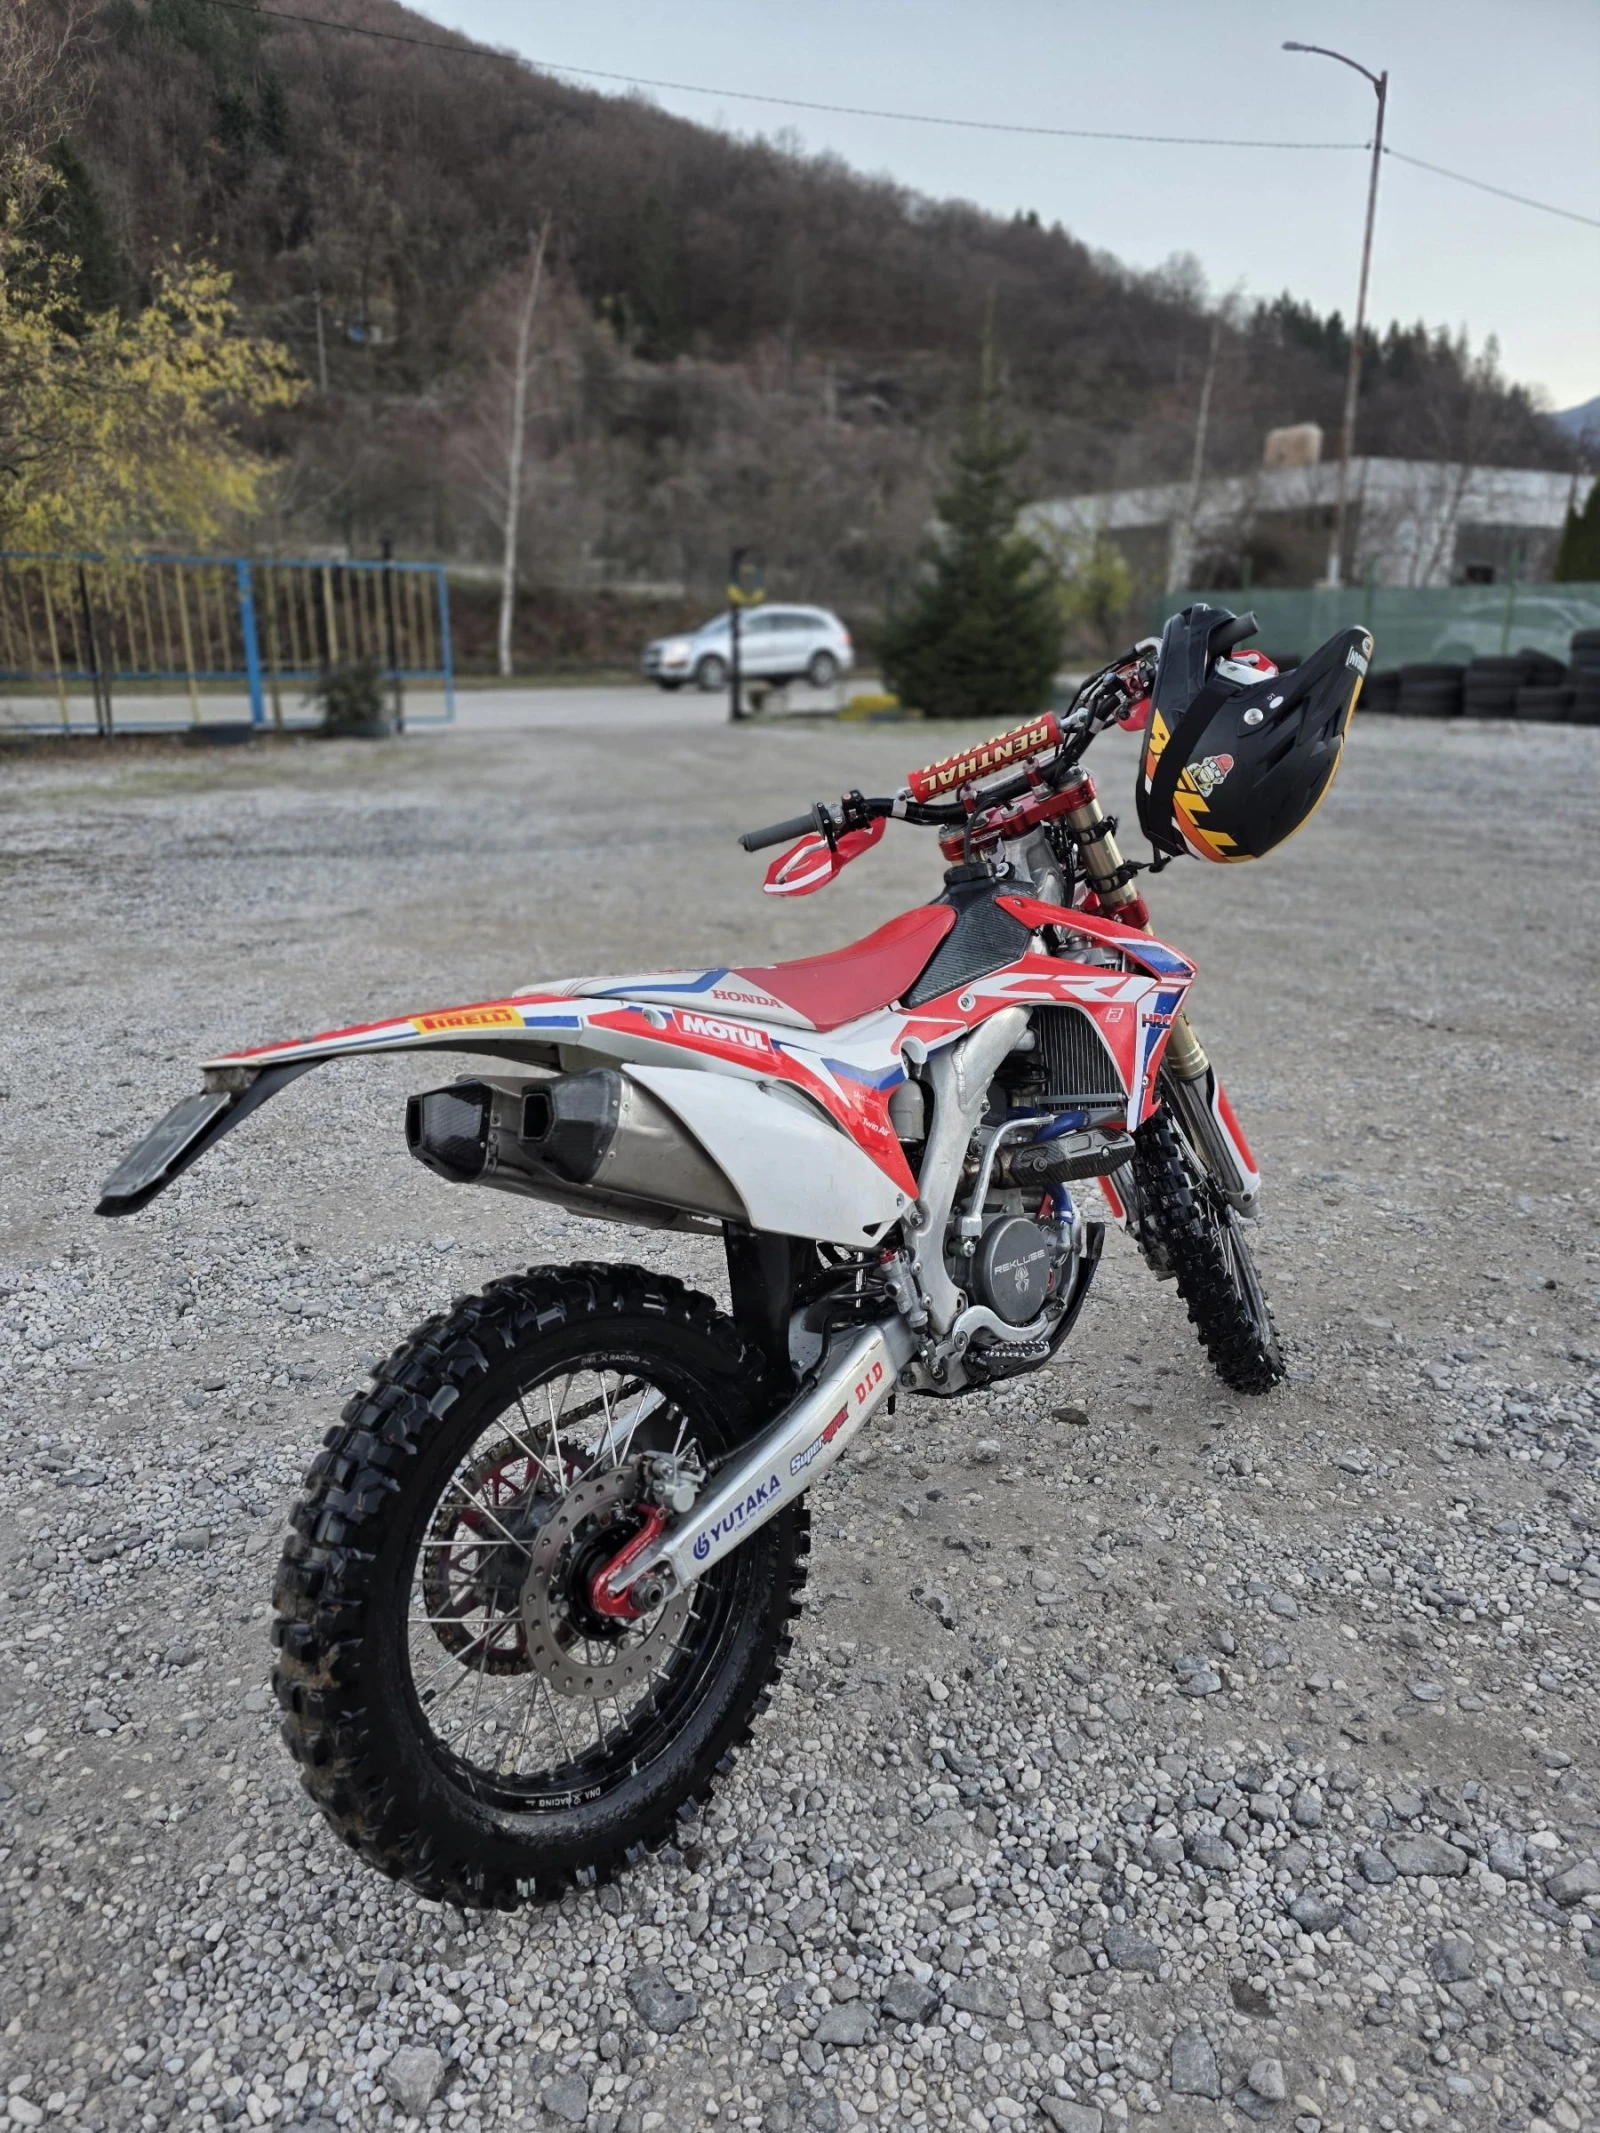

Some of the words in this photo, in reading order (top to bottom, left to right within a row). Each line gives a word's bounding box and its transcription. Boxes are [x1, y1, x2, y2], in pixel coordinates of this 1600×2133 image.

[921, 725, 1048, 791] RENTHAL
[711, 988, 784, 1009] HONDA
[421, 1009, 512, 1031] PIRELLI
[1142, 1013, 1172, 1029] HRC
[682, 1014, 769, 1050] MOTUL
[862, 1116, 879, 1133] Twin
[878, 1126, 891, 1137] Air
[994, 1249, 1045, 1276] REKLUSE
[609, 1354, 640, 1363] RACING
[710, 1474, 781, 1543] YUTAKA
[584, 1786, 601, 1800] DNA
